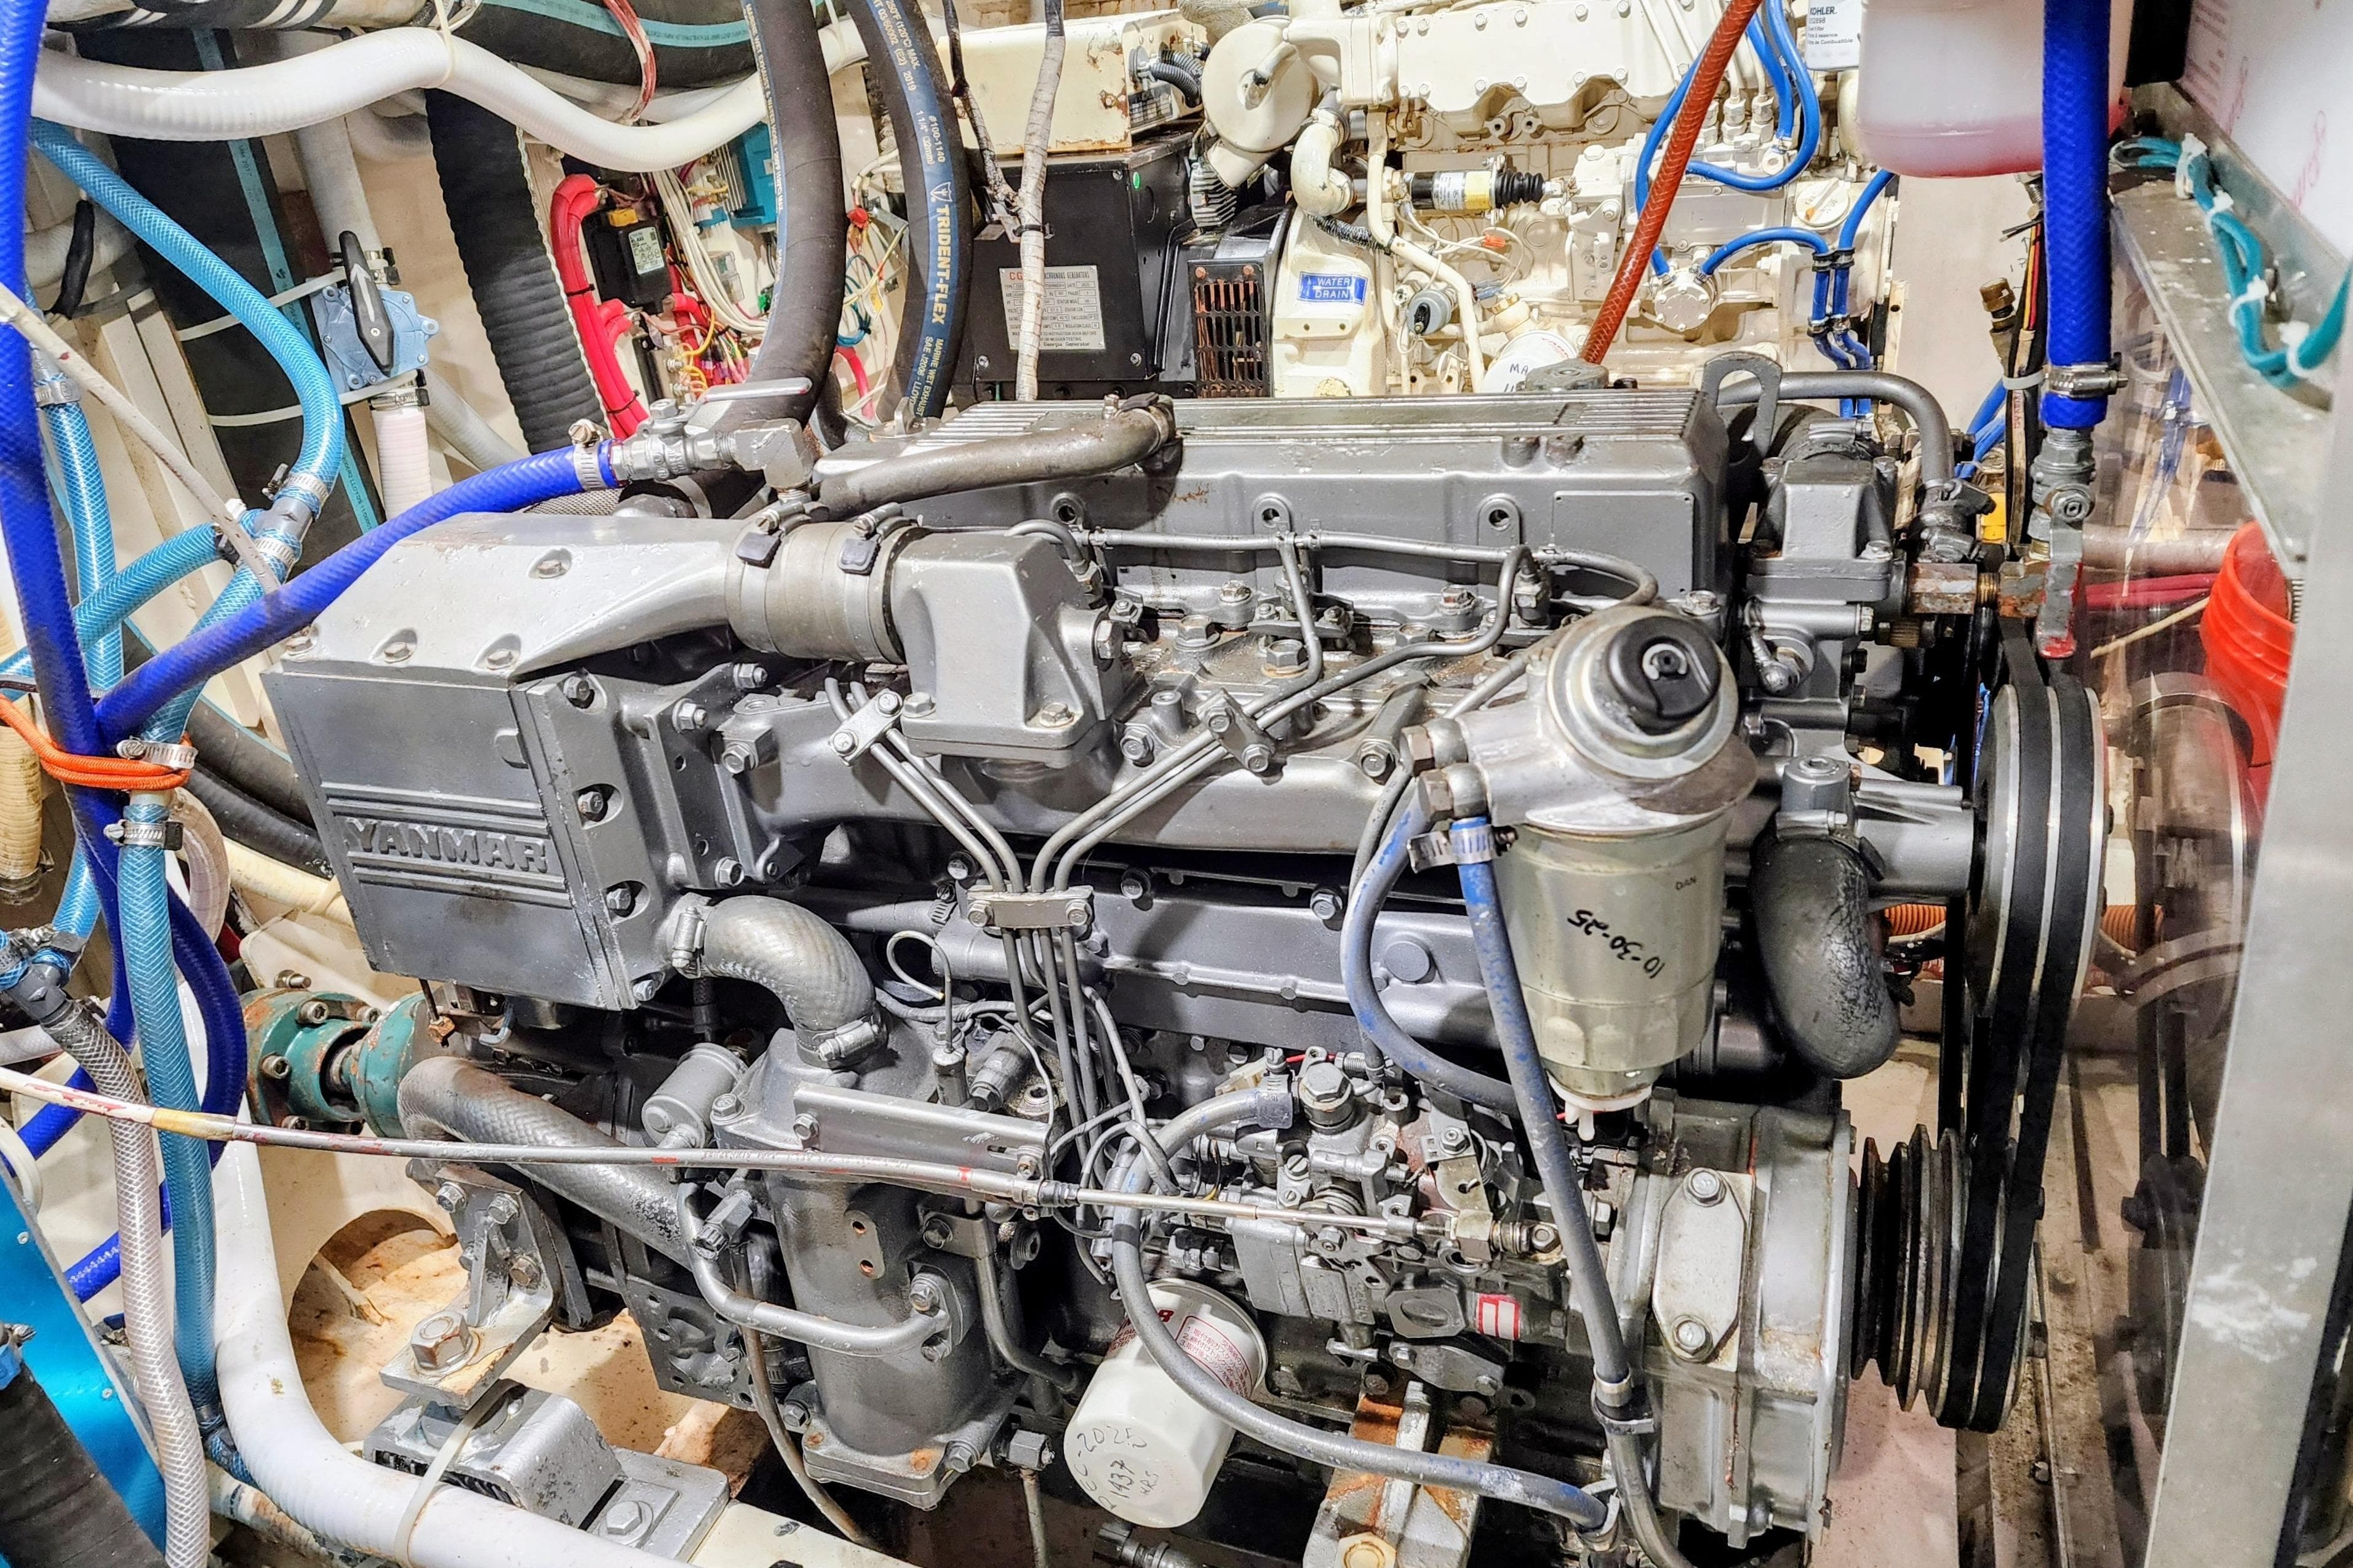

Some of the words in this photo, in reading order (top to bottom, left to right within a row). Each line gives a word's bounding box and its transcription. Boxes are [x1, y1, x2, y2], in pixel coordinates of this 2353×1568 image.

[903, 71, 916, 91] 2019
[932, 204, 952, 325] TRIDENT-FLEX
[1317, 277, 1351, 286] WATER
[923, 336, 934, 354] SAE
[930, 338, 944, 368] MARINE
[925, 369, 937, 385] WET
[916, 385, 932, 416] EXHAUST
[345, 817, 548, 874] YANMAR
[1567, 909, 1666, 979] 10-30-25
[1108, 1460, 1135, 1499] 1437
